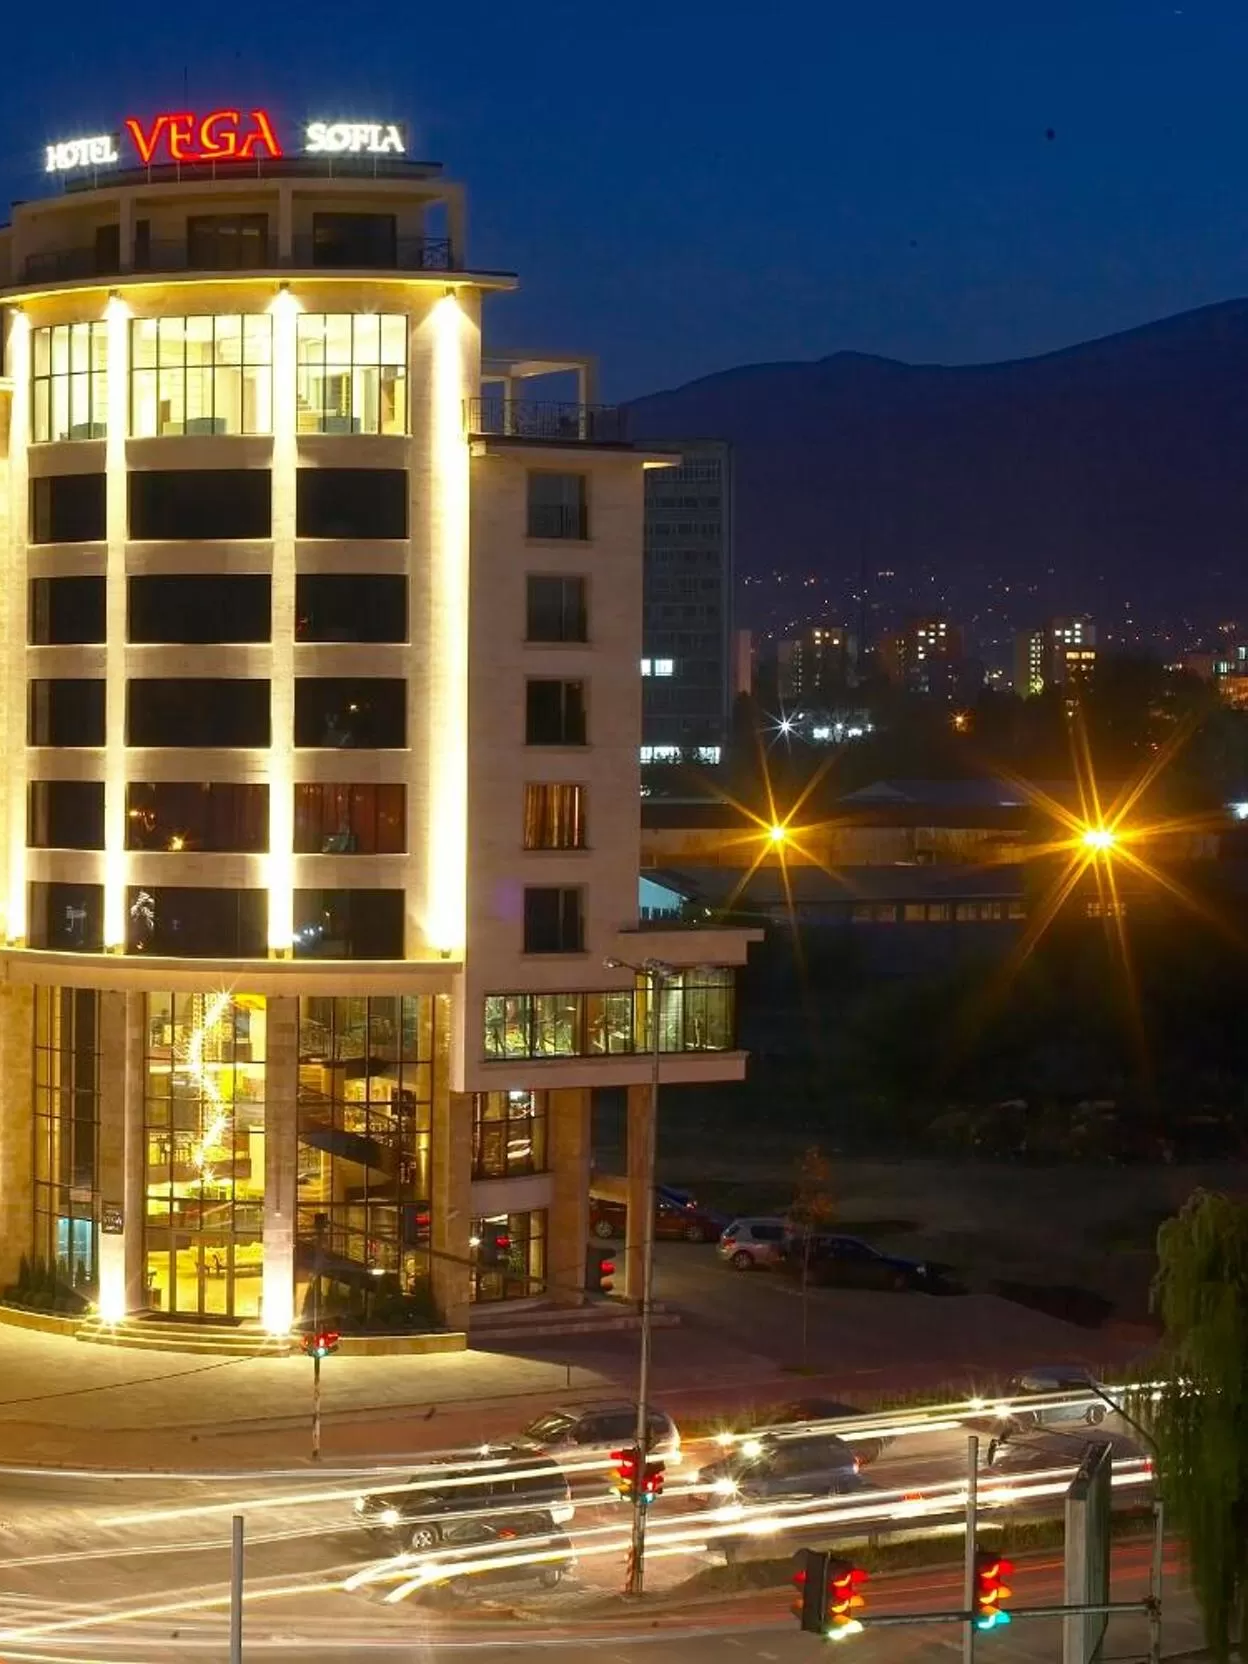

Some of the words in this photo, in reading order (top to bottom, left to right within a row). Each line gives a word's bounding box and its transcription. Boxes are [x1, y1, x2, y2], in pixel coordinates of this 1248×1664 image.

[46, 135, 118, 172] HOTEL
[124, 108, 283, 164] VEGA
[305, 122, 405, 152] SOFIA
